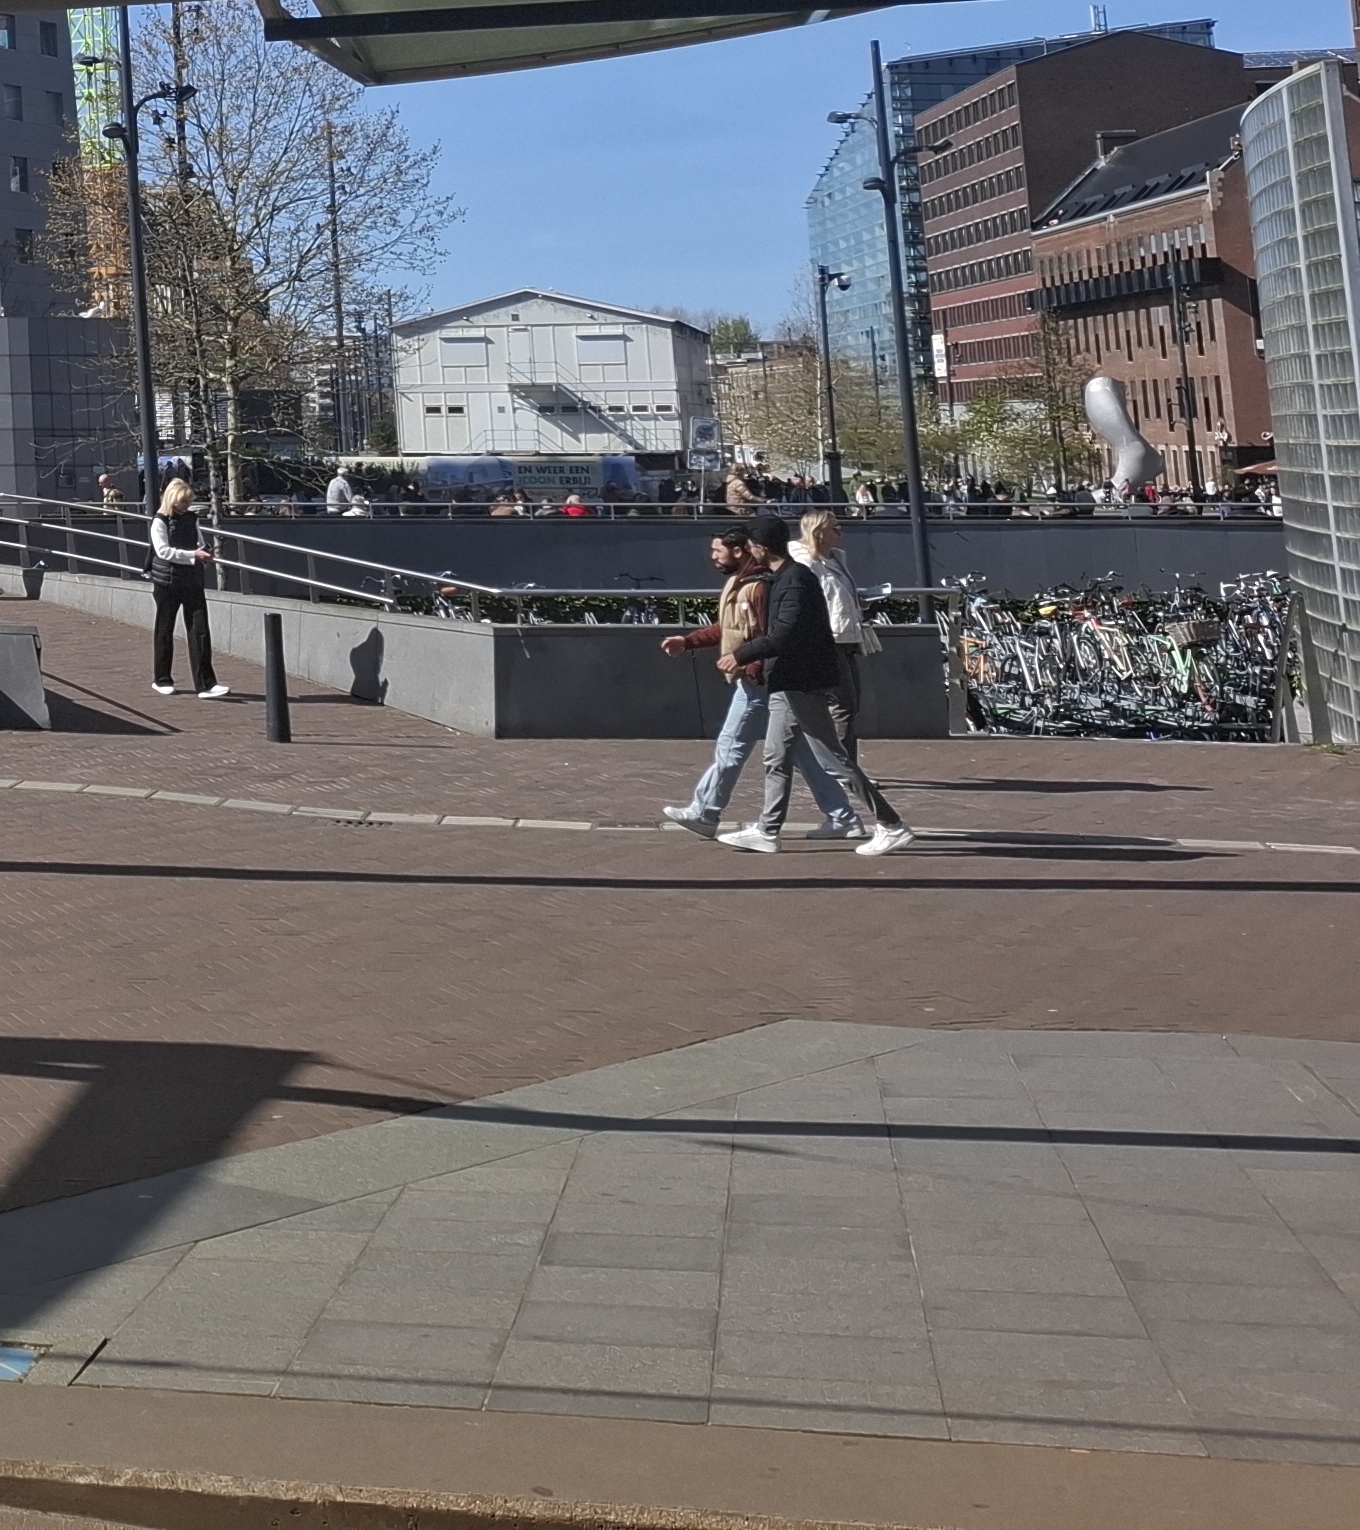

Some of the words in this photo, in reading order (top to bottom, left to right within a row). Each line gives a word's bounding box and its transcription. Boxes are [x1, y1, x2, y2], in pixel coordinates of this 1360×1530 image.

[518, 466, 532, 474] EN
[535, 466, 565, 474] WEER
[569, 466, 590, 474] EEN
